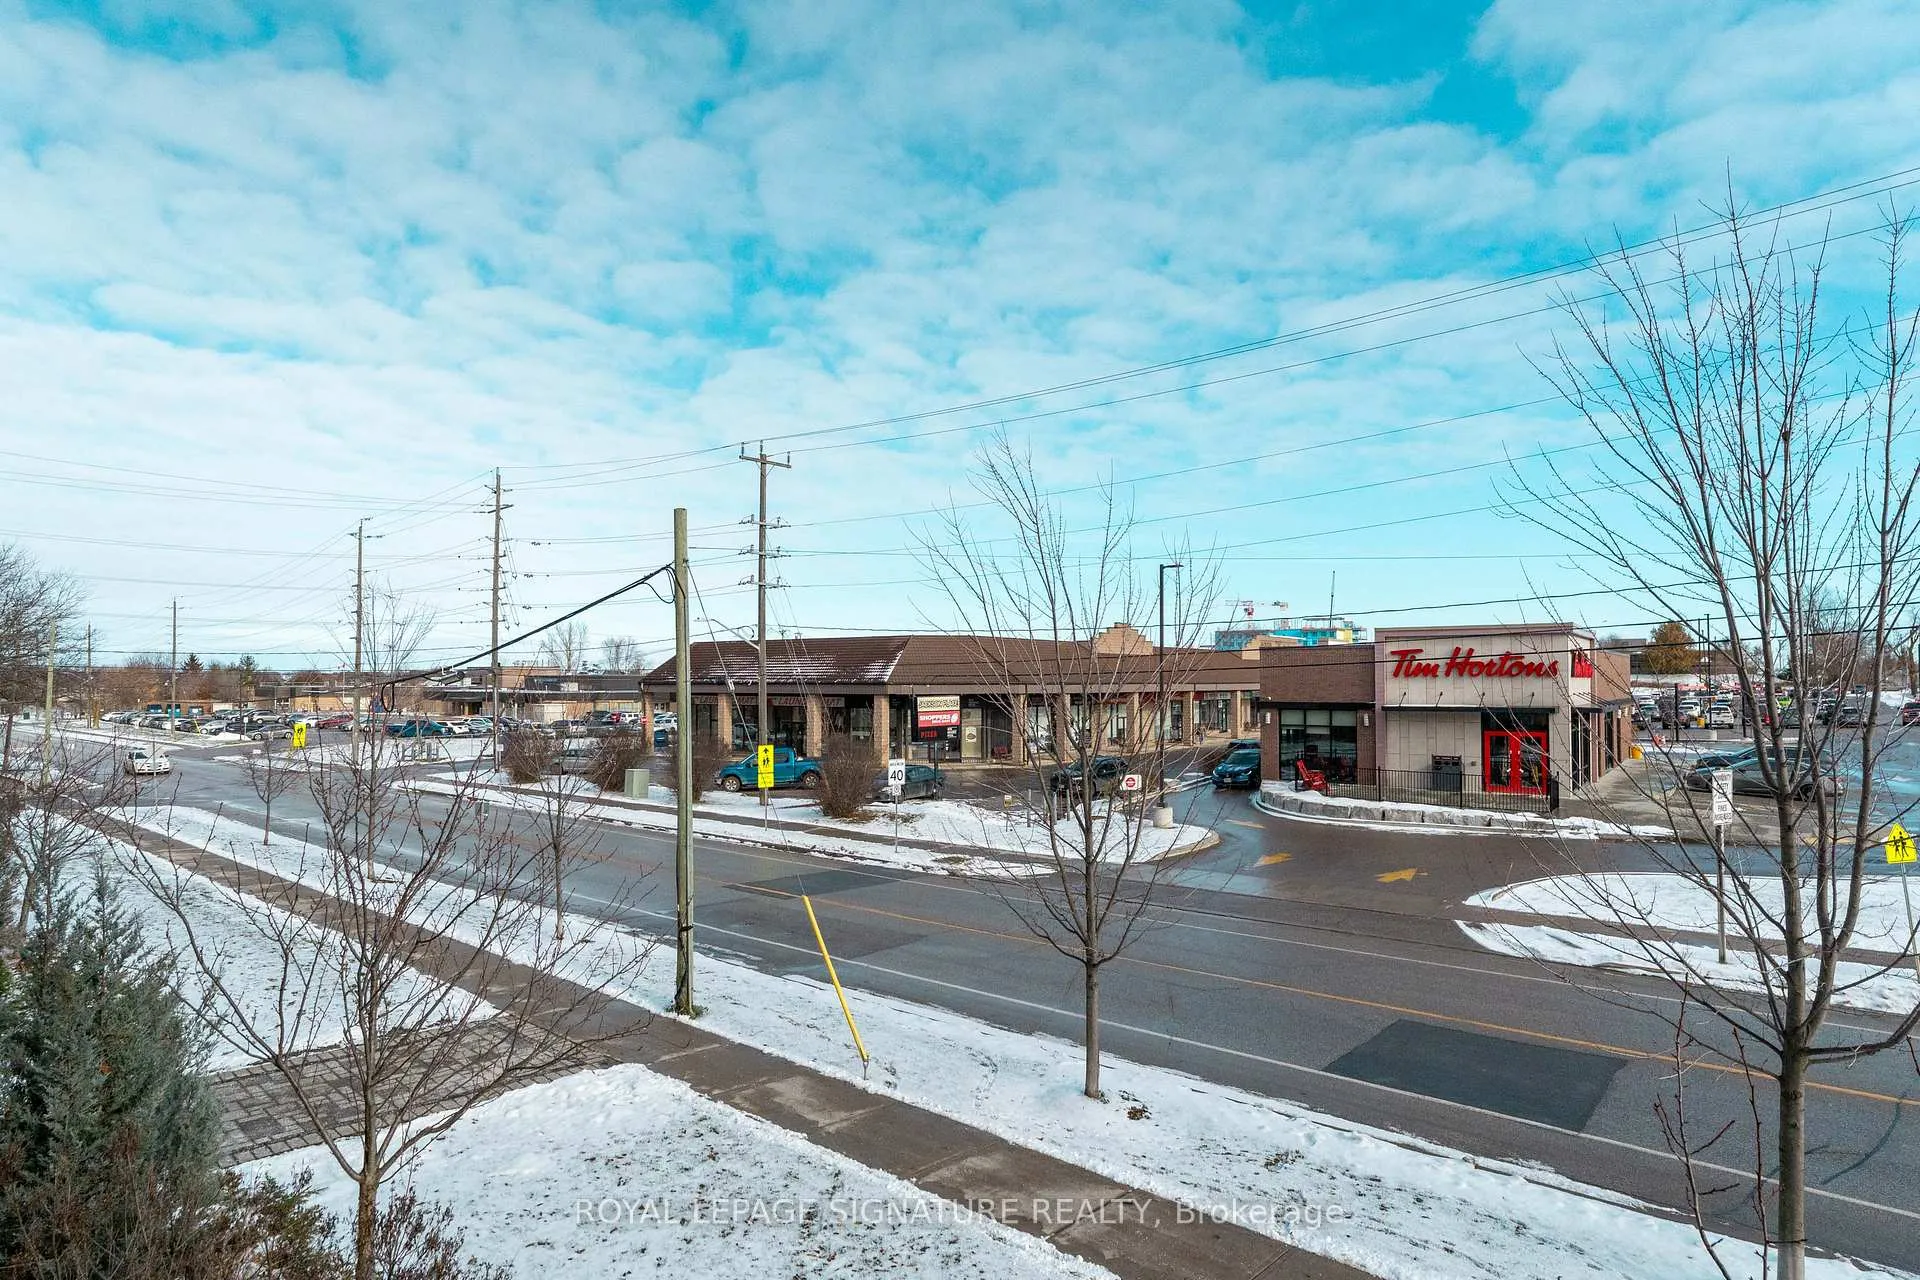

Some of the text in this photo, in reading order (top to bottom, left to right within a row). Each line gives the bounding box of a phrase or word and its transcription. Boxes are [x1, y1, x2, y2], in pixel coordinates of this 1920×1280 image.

[1390, 648, 1438, 678] Tim
[1445, 646, 1559, 678] Hortons
[890, 769, 903, 781] 40
